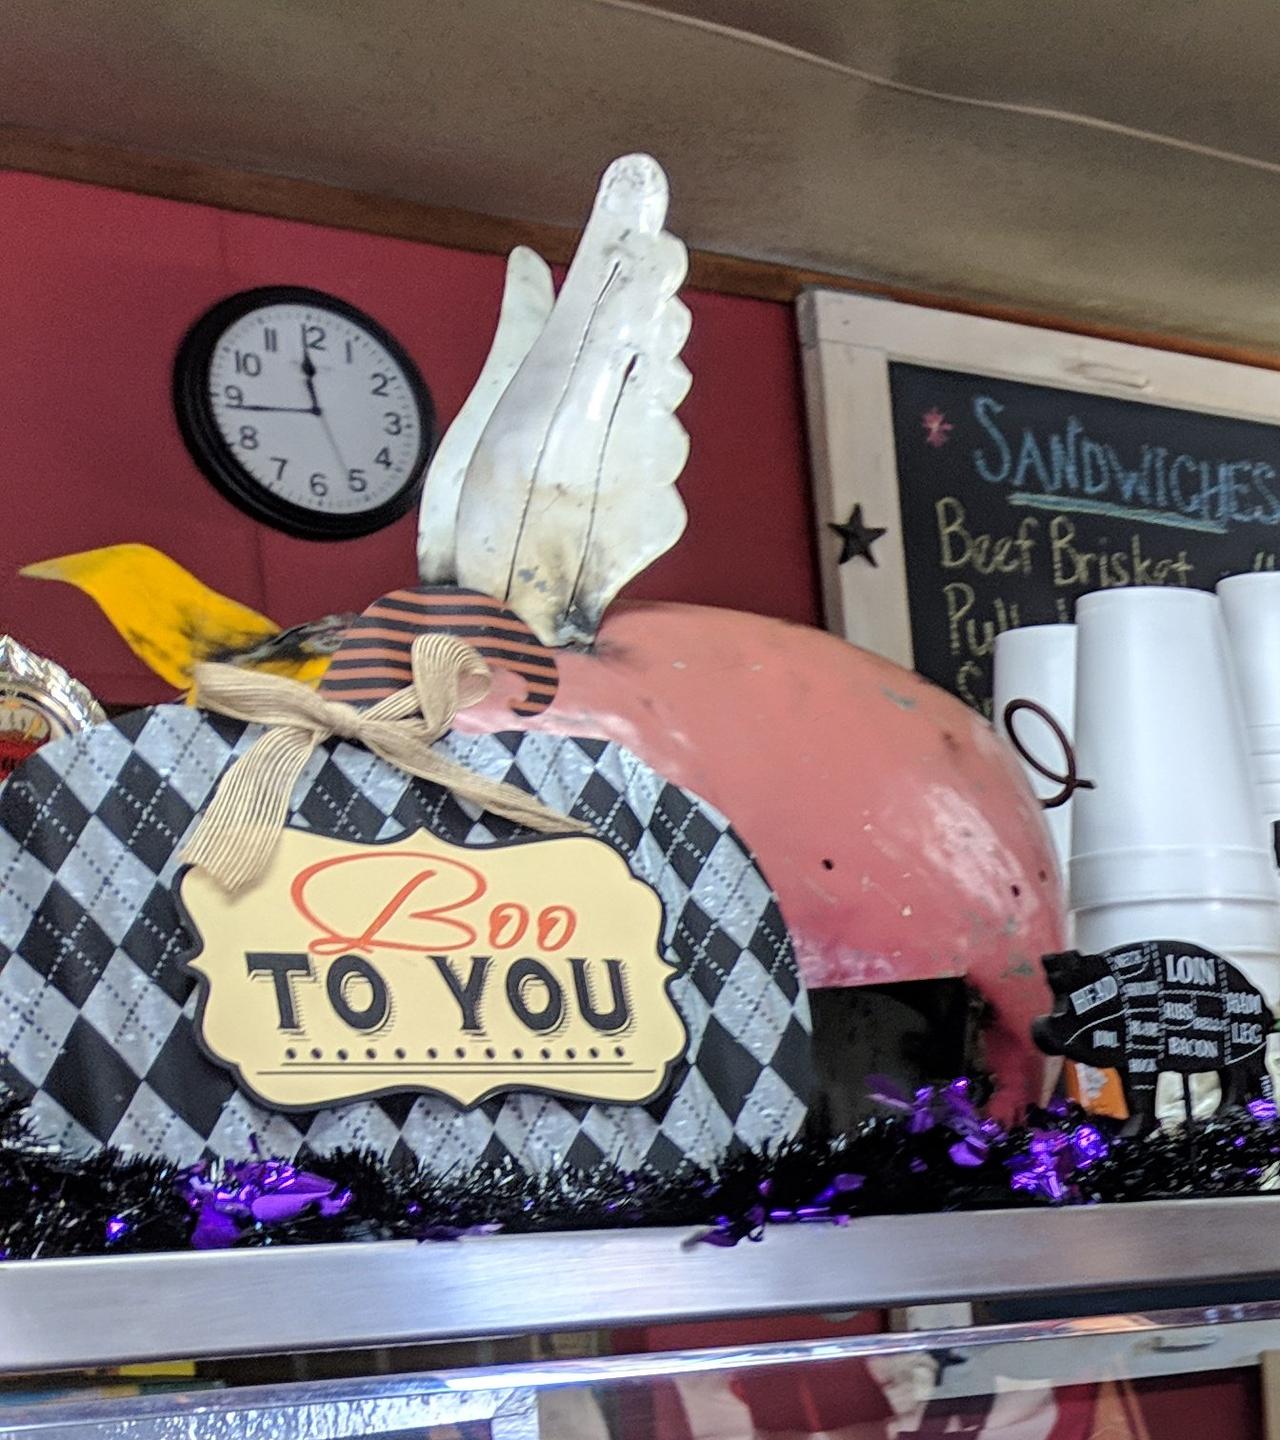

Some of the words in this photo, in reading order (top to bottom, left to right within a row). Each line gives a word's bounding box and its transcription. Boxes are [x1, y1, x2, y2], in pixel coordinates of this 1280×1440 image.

[263, 327, 279, 353] 11
[234, 351, 262, 378] 10
[225, 384, 244, 407] 9
[370, 372, 391, 398] 2
[384, 411, 402, 436] 3
[239, 425, 259, 450] 8
[269, 457, 289, 482] 7
[375, 447, 393, 471] 4
[309, 472, 329, 498] 6
[347, 468, 368, 493] 5
[935, 495, 1037, 576] Beef
[290, 850, 578, 956] Boo
[1165, 954, 1216, 986] LOIN
[244, 951, 394, 1038] TO
[427, 955, 634, 1038] YOU
[1168, 1036, 1219, 1058] BACON
